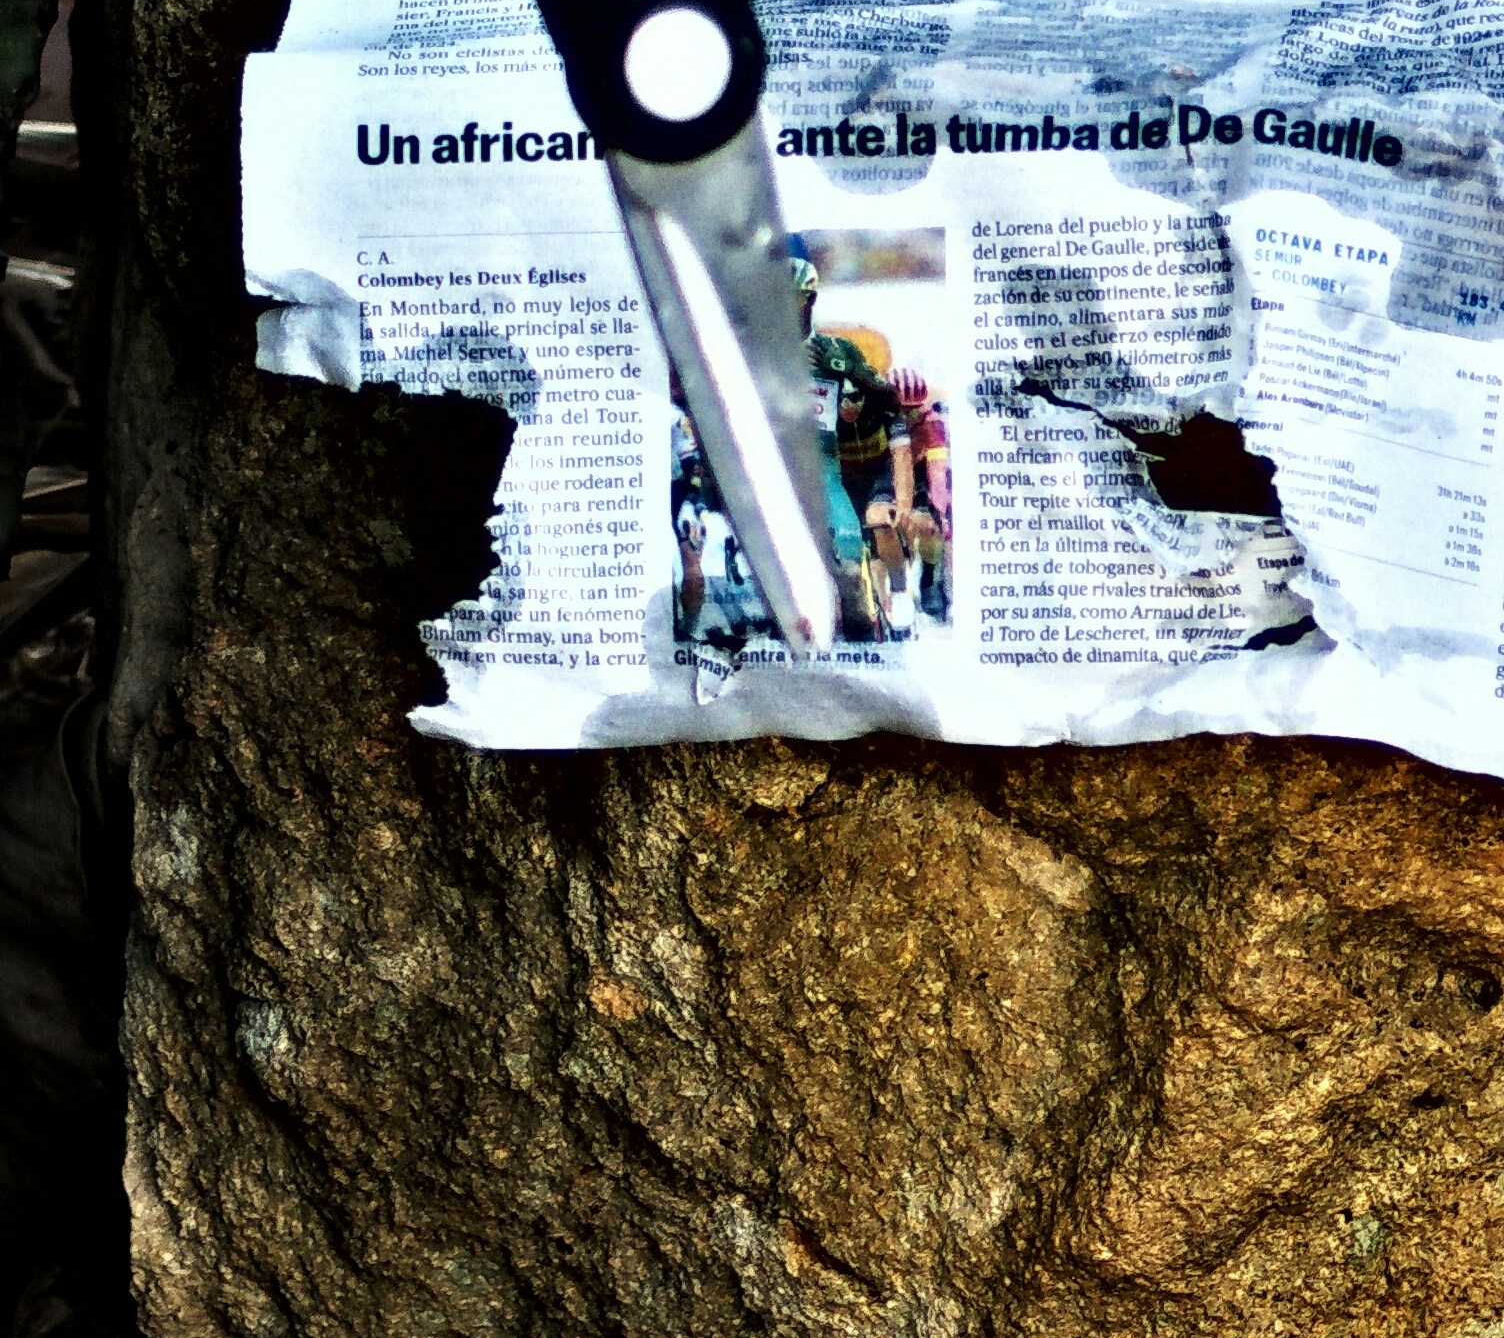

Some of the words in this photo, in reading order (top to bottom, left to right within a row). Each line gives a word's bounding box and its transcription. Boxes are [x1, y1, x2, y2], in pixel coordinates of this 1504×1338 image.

[356, 123, 421, 165] Un
[432, 120, 604, 164] african
[775, 122, 886, 159] ante
[894, 113, 937, 157] la
[945, 114, 1100, 155] tumba
[1109, 110, 1169, 151] de
[1178, 103, 1243, 146] De
[1252, 107, 1404, 167] Gaulle
[356, 251, 373, 266] C.
[377, 251, 395, 266] A.
[1254, 248, 1302, 265] SEMUR
[1255, 228, 1322, 254] OCTAVA
[1334, 243, 1389, 266] ETAPA
[358, 271, 444, 290] Colombey
[449, 271, 473, 287] les
[478, 269, 523, 286] Deux
[528, 266, 588, 287] Églises
[1271, 269, 1348, 295] COLOMBEY
[359, 301, 383, 318] En
[390, 297, 487, 317] Montbard,
[493, 300, 517, 314] no
[523, 301, 563, 316] muy
[570, 295, 612, 314] lejos
[617, 295, 640, 313] de
[1250, 297, 1285, 313] Etapa
[359, 320, 374, 341] la
[379, 320, 436, 340] salida,
[440, 321, 456, 340] la
[459, 319, 500, 339] calle
[505, 316, 585, 341] principal
[589, 320, 609, 336] se
[612, 317, 640, 336] lla-
[973, 311, 990, 328] el
[994, 312, 1064, 329] camino,
[1068, 306, 1166, 326] alimentara
[1171, 306, 1199, 321] sus
[973, 332, 1019, 351] culos
[1023, 336, 1046, 350] en
[1050, 331, 1067, 349] el
[1071, 328, 1149, 348] esfuerzo
[1153, 323, 1233, 347] espléndido
[421, 624, 482, 644] Biniam
[487, 628, 556, 648] Girmay,
[561, 630, 594, 645] una
[599, 626, 647, 645] bom-
[980, 626, 995, 643] el
[998, 626, 1036, 642] Toro
[1039, 624, 1061, 641] de
[1064, 625, 1150, 644] Lescheret,
[1155, 627, 1177, 641] un
[1181, 626, 1247, 647] sprinter
[739, 649, 786, 664] entra
[836, 651, 886, 665] meta.
[980, 646, 1059, 667] compacto
[1062, 646, 1084, 664] de
[1086, 645, 1164, 665] dinamita,
[1168, 649, 1199, 667] que
